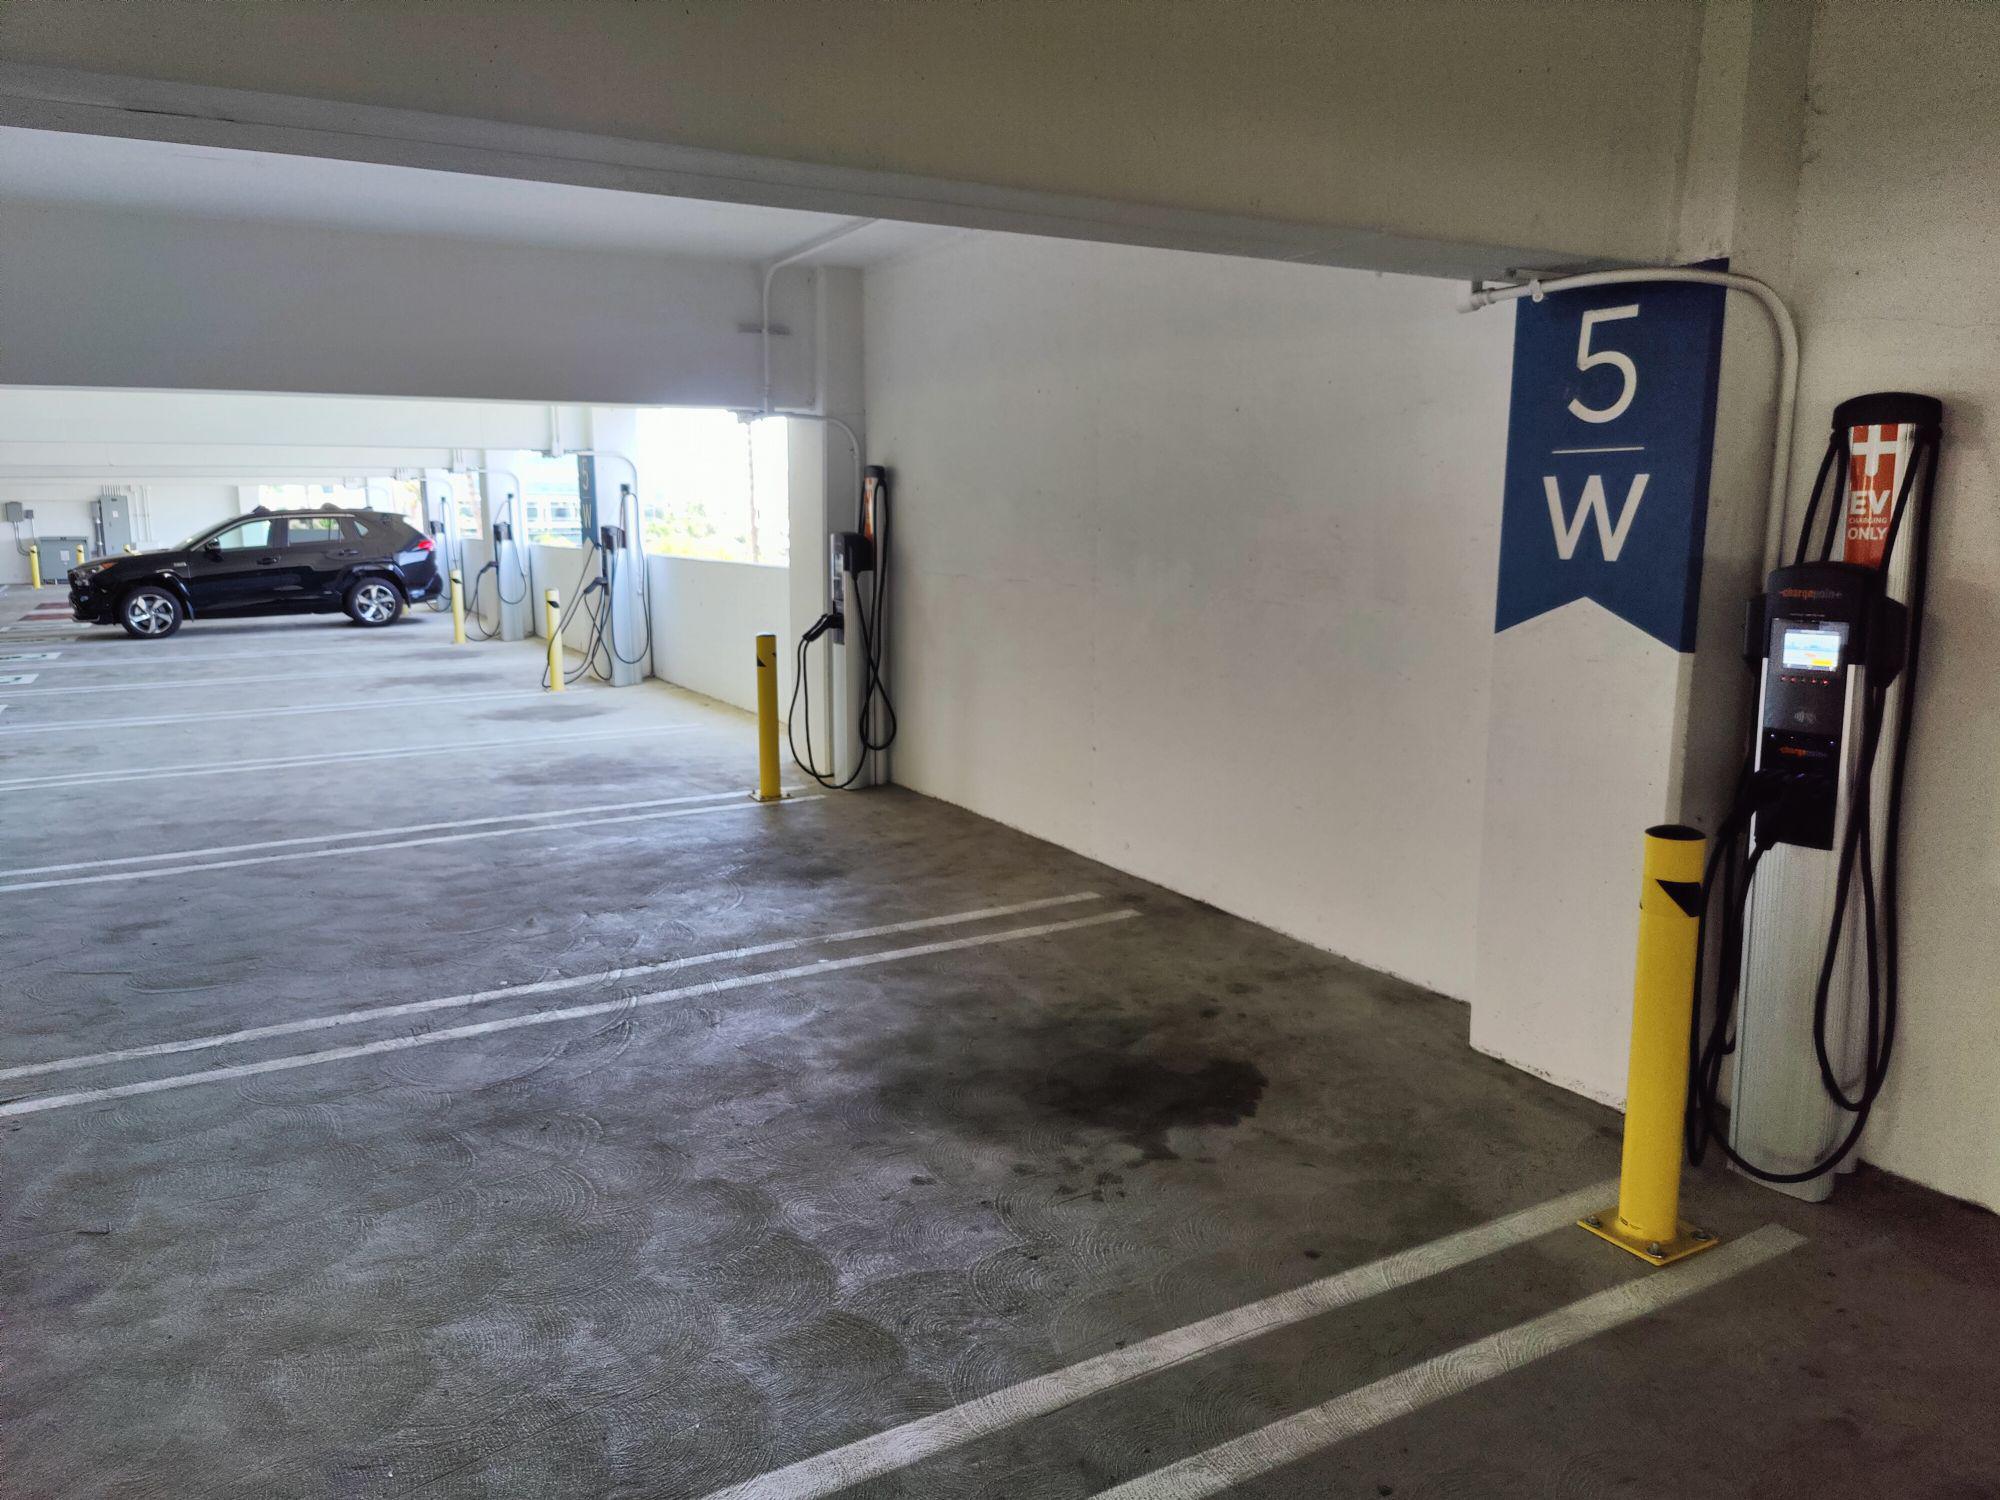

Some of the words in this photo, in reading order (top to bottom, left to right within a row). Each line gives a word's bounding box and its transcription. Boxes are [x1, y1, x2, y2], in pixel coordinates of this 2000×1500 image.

[1568, 304, 1639, 423] 5
[582, 457, 589, 490] 5
[582, 503, 592, 528] W
[1850, 489, 1891, 515] EV
[1543, 473, 1650, 562] W
[1847, 527, 1888, 540] ONLY
